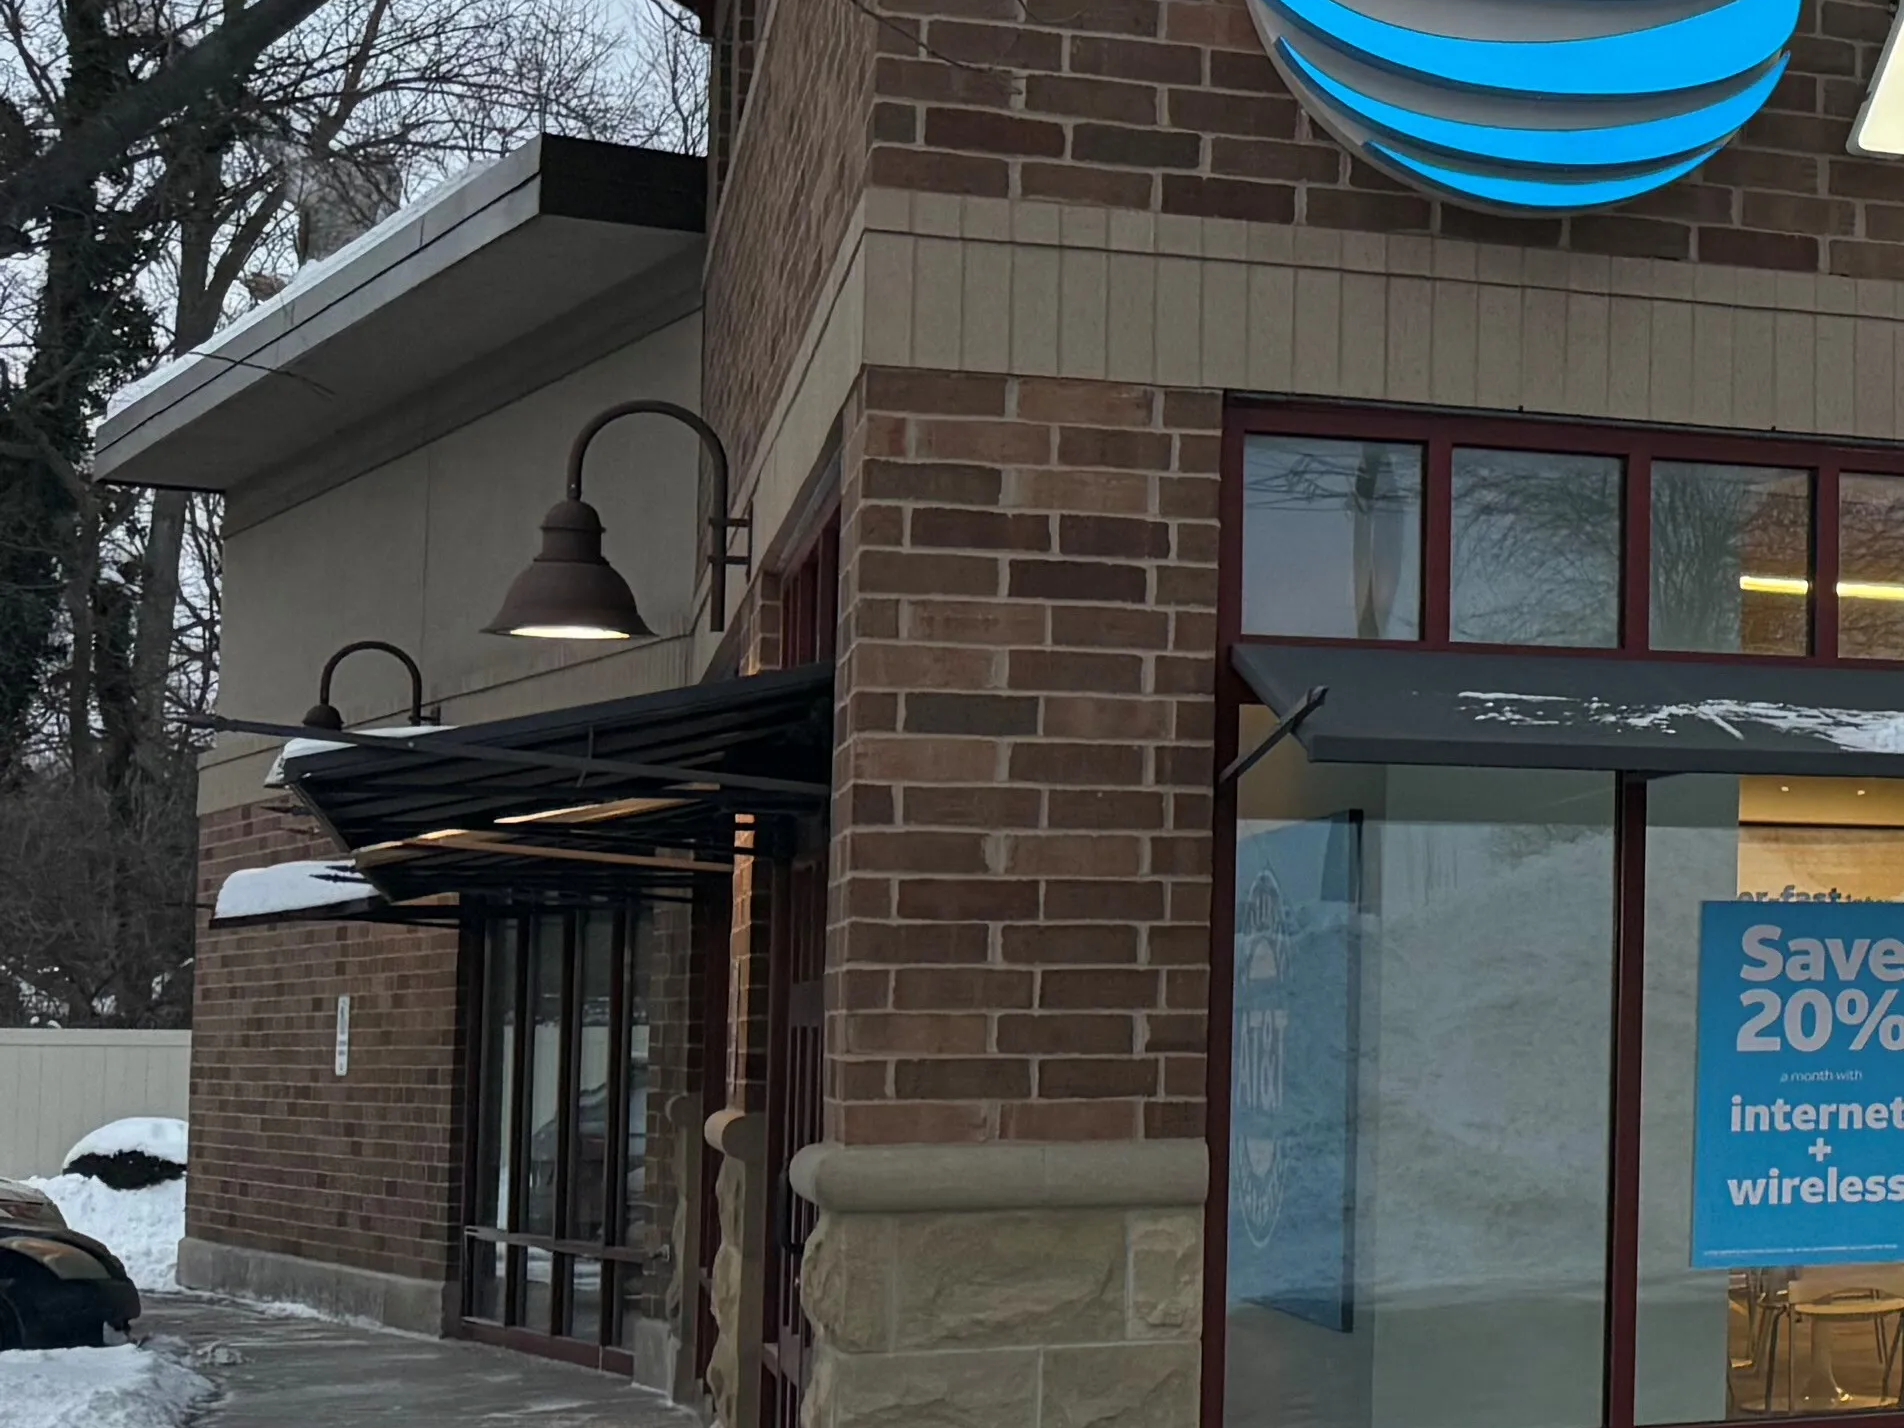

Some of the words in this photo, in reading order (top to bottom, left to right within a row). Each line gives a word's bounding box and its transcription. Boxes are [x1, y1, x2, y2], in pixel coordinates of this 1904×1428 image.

[1791, 1070, 1834, 1082] month
[1836, 1070, 1862, 1081] with
[1808, 1137, 1831, 1162] +
